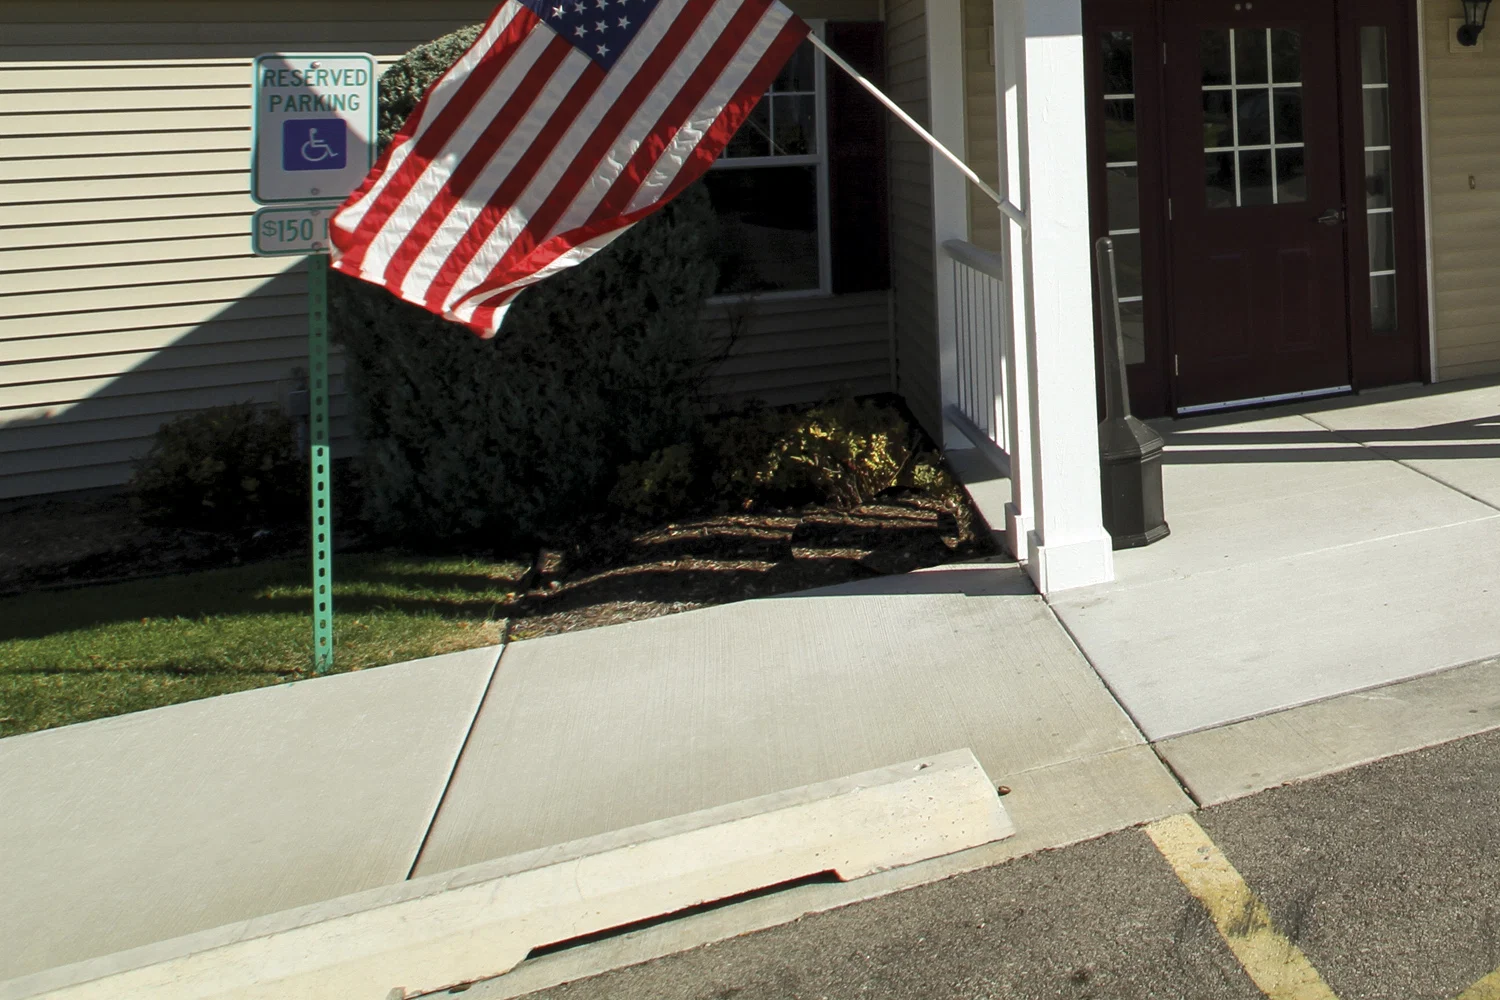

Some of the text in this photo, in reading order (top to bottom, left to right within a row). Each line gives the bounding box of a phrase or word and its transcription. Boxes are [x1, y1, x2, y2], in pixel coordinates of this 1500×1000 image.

[263, 68, 368, 88] RESERVED
[269, 93, 360, 113] PARKING
[262, 218, 314, 242] $150
